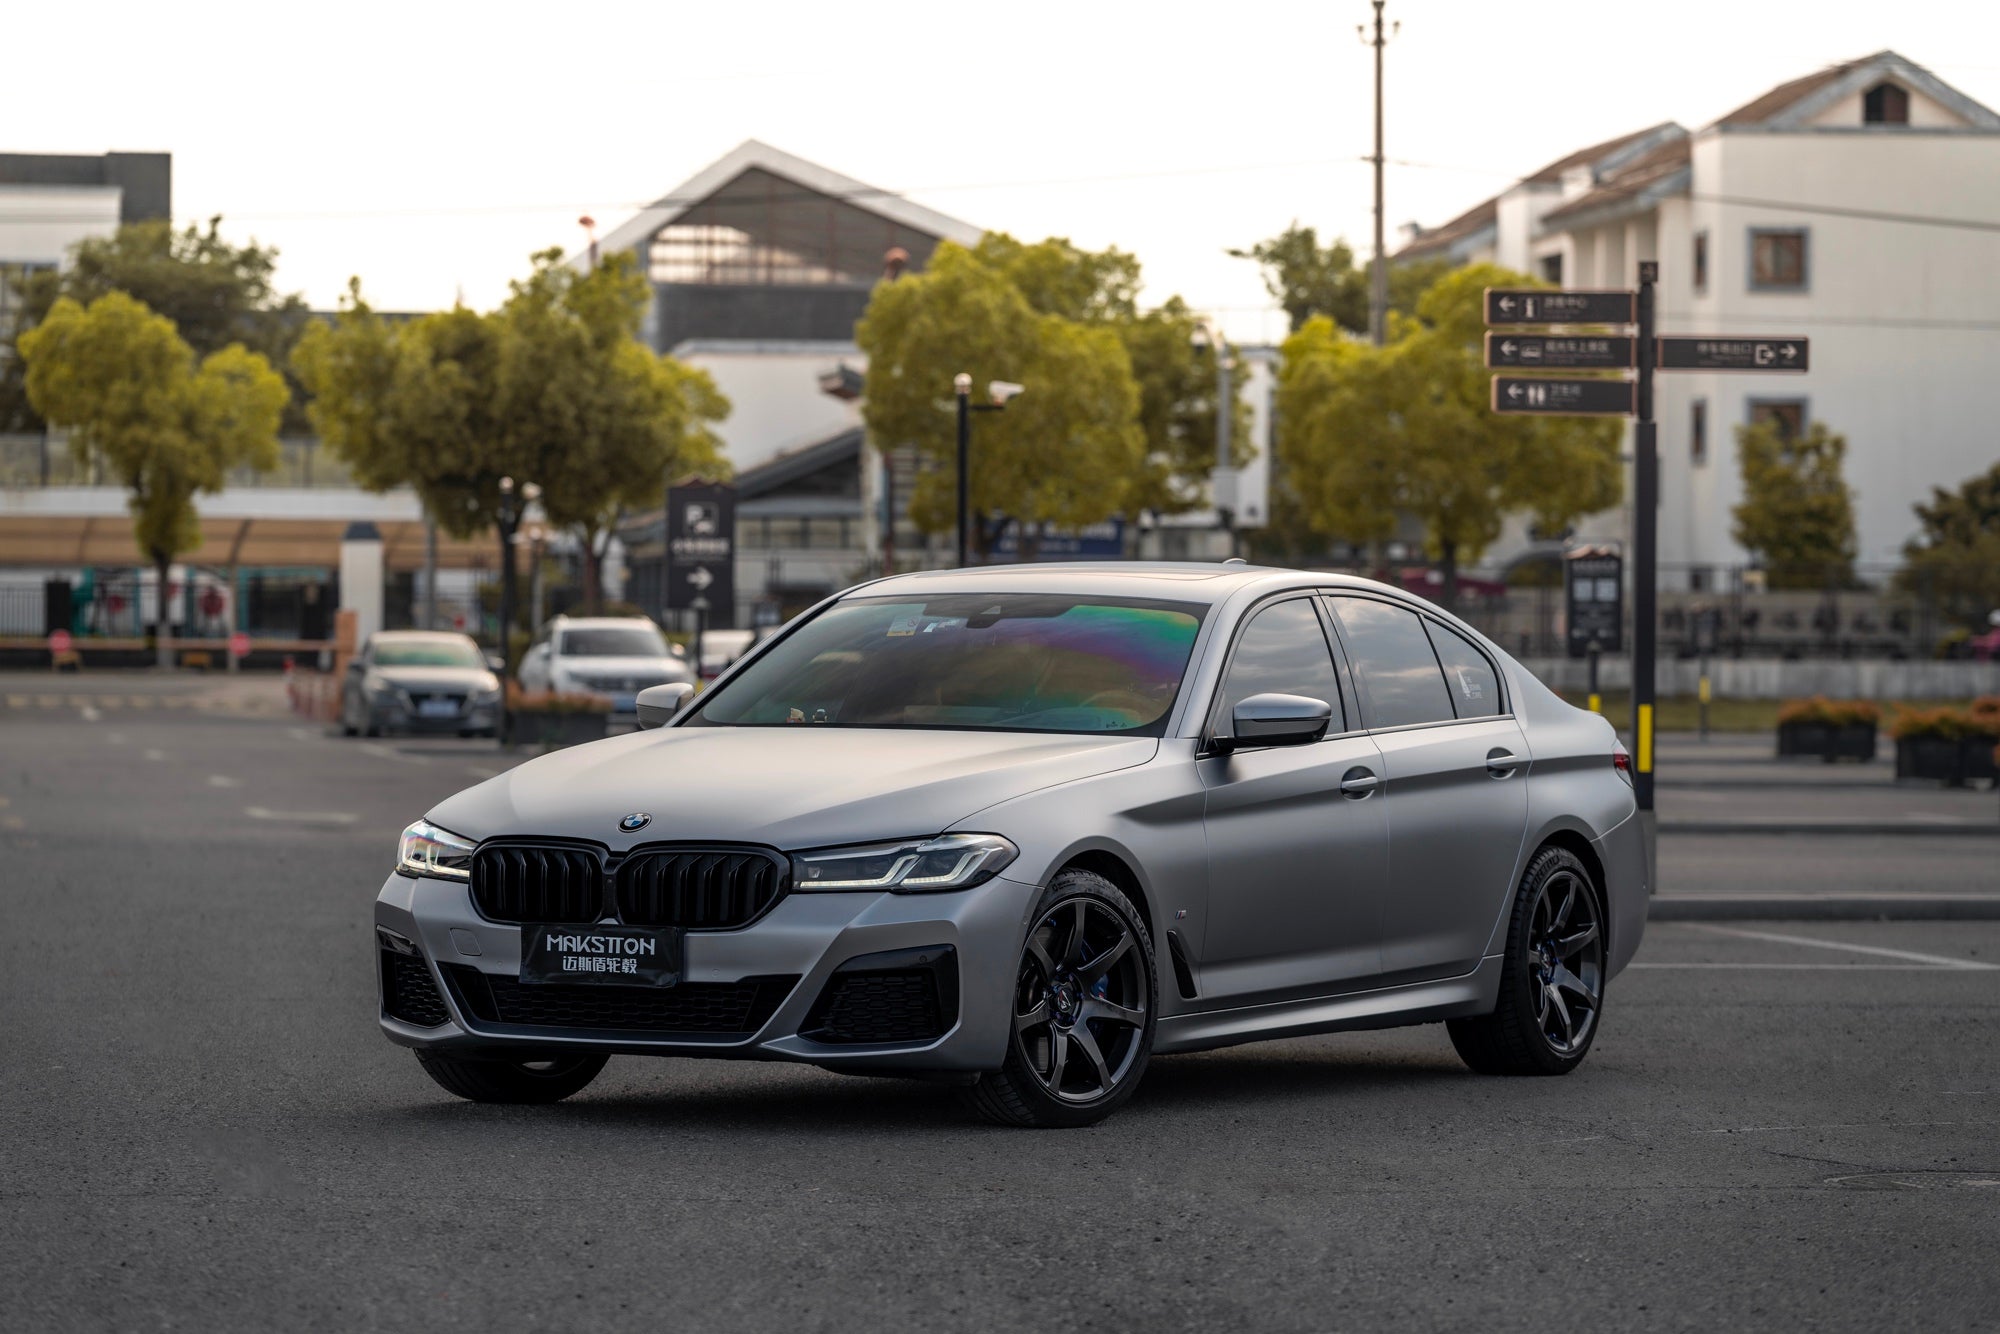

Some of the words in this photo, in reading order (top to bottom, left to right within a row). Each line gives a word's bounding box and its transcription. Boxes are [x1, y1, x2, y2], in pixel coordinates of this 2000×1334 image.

[562, 955, 638, 974] 迈斯盾轮毂
